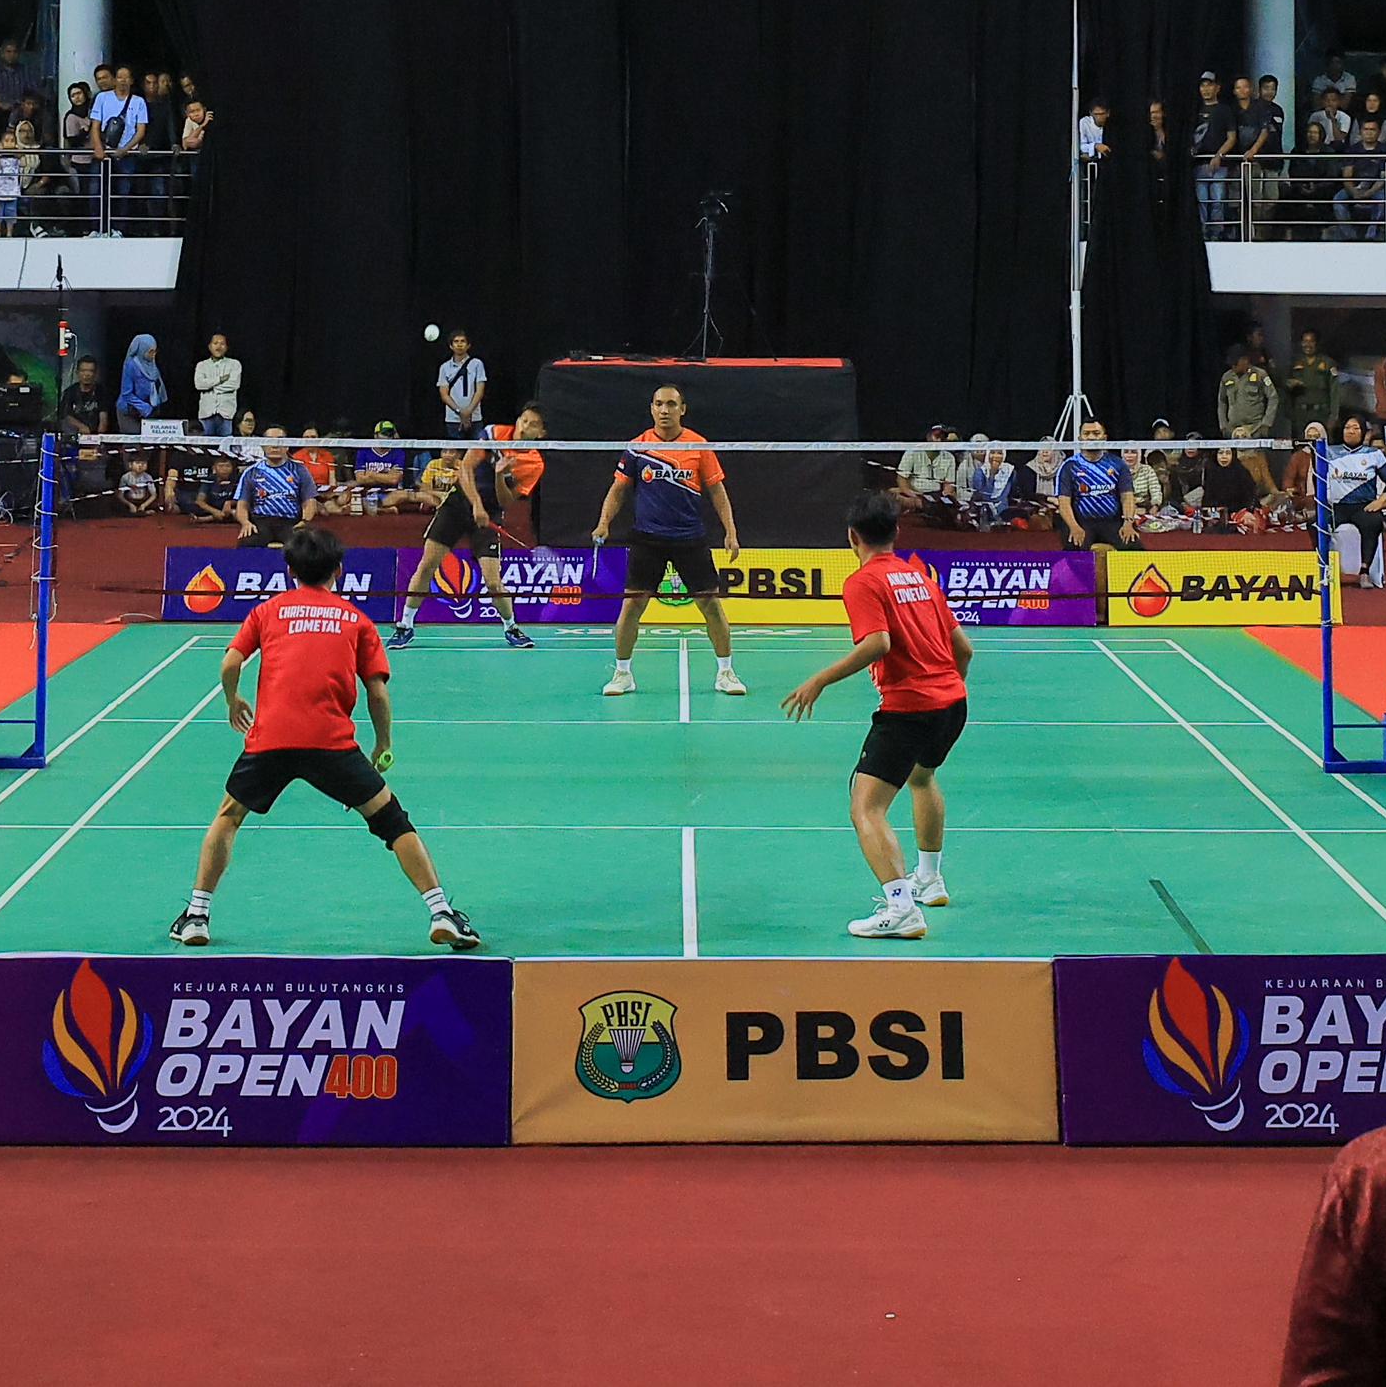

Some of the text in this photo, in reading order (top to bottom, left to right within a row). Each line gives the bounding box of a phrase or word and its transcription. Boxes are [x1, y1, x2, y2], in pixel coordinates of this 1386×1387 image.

[655, 469, 693, 480] BAYAN
[234, 573, 371, 600] BAN
[482, 563, 584, 584] AYAN
[719, 568, 825, 598] PBSI
[948, 568, 1051, 589] BAYAN
[1179, 574, 1315, 603] BAYAN
[289, 620, 341, 634] COMETAL
[173, 981, 406, 993] KEJUARAAN BULUTANGKIS
[1265, 978, 1366, 989] KEJUARAAN
[160, 999, 406, 1049] BAYAN
[600, 1001, 652, 1027] PBSI
[726, 1011, 966, 1080] PBSI
[158, 1106, 233, 1137] 2024
[1264, 1101, 1340, 1134] 2024
